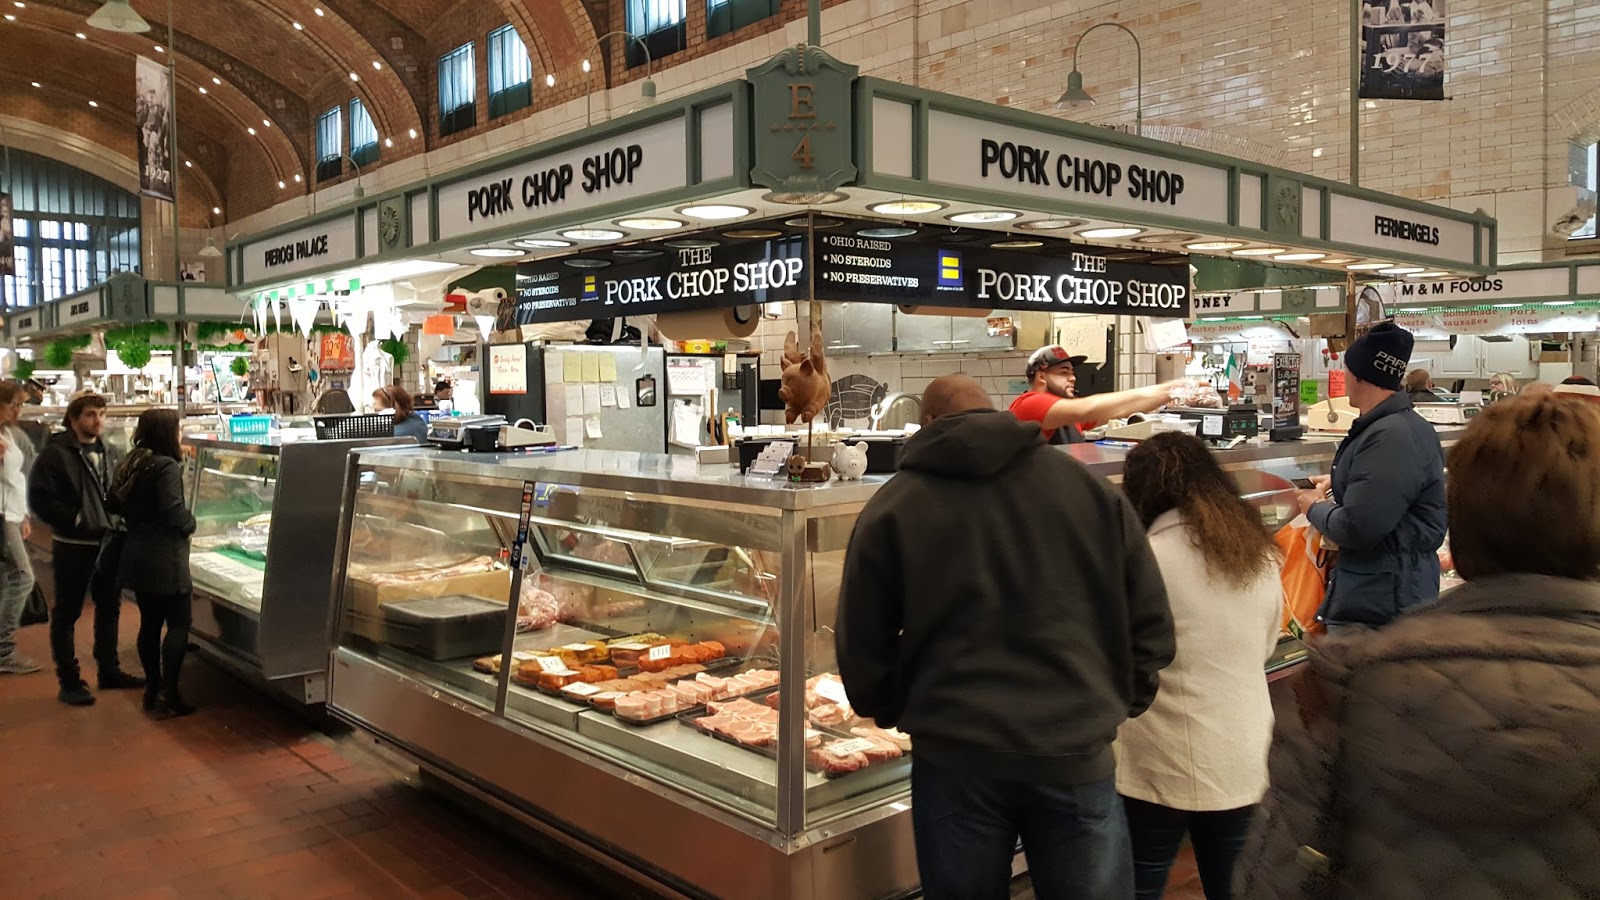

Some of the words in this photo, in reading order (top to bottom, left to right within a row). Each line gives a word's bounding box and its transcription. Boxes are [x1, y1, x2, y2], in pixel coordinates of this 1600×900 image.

[1370, 53, 1432, 73] 1977
[787, 83, 817, 120] E
[791, 133, 815, 169] 4
[144, 165, 170, 184] 1927
[981, 138, 1050, 186] PORK
[1057, 153, 1122, 197] CHOP
[1128, 164, 1184, 205] SHOP
[468, 178, 514, 221] PORK
[522, 163, 573, 207] CHOP
[581, 144, 643, 193] SHOP
[1375, 215, 1439, 246] FERNENGELS
[264, 243, 294, 268] PIEROGI
[296, 234, 328, 260] PALACE
[830, 235, 855, 247] OHIO
[856, 239, 892, 251] RAISED
[678, 247, 712, 267] THE
[830, 254, 844, 264] NO
[845, 255, 892, 269] STEROIDS
[1071, 252, 1106, 273] THE
[538, 272, 559, 282] RAISED
[604, 276, 663, 306] PORK
[666, 268, 729, 299] CHOP
[733, 257, 803, 292] SHOP
[830, 271, 845, 282] NO
[846, 272, 919, 288] PRESERVATIVES
[523, 289, 532, 297] NO
[532, 286, 559, 296] STEROIDS
[977, 268, 1053, 303] PORK
[1056, 273, 1123, 305] CHOP
[1126, 279, 1186, 308] SHOP
[1402, 284, 1414, 295] M
[1418, 283, 1428, 295] &
[1432, 282, 1444, 294] M
[1450, 279, 1503, 293] FOODS
[523, 302, 532, 310] NO
[531, 297, 577, 310] PRESERVATIVES
[1219, 324, 1244, 332] breast
[1443, 317, 1488, 327] sausages
[1511, 317, 1539, 326] loins
[1373, 360, 1405, 378] CITY
